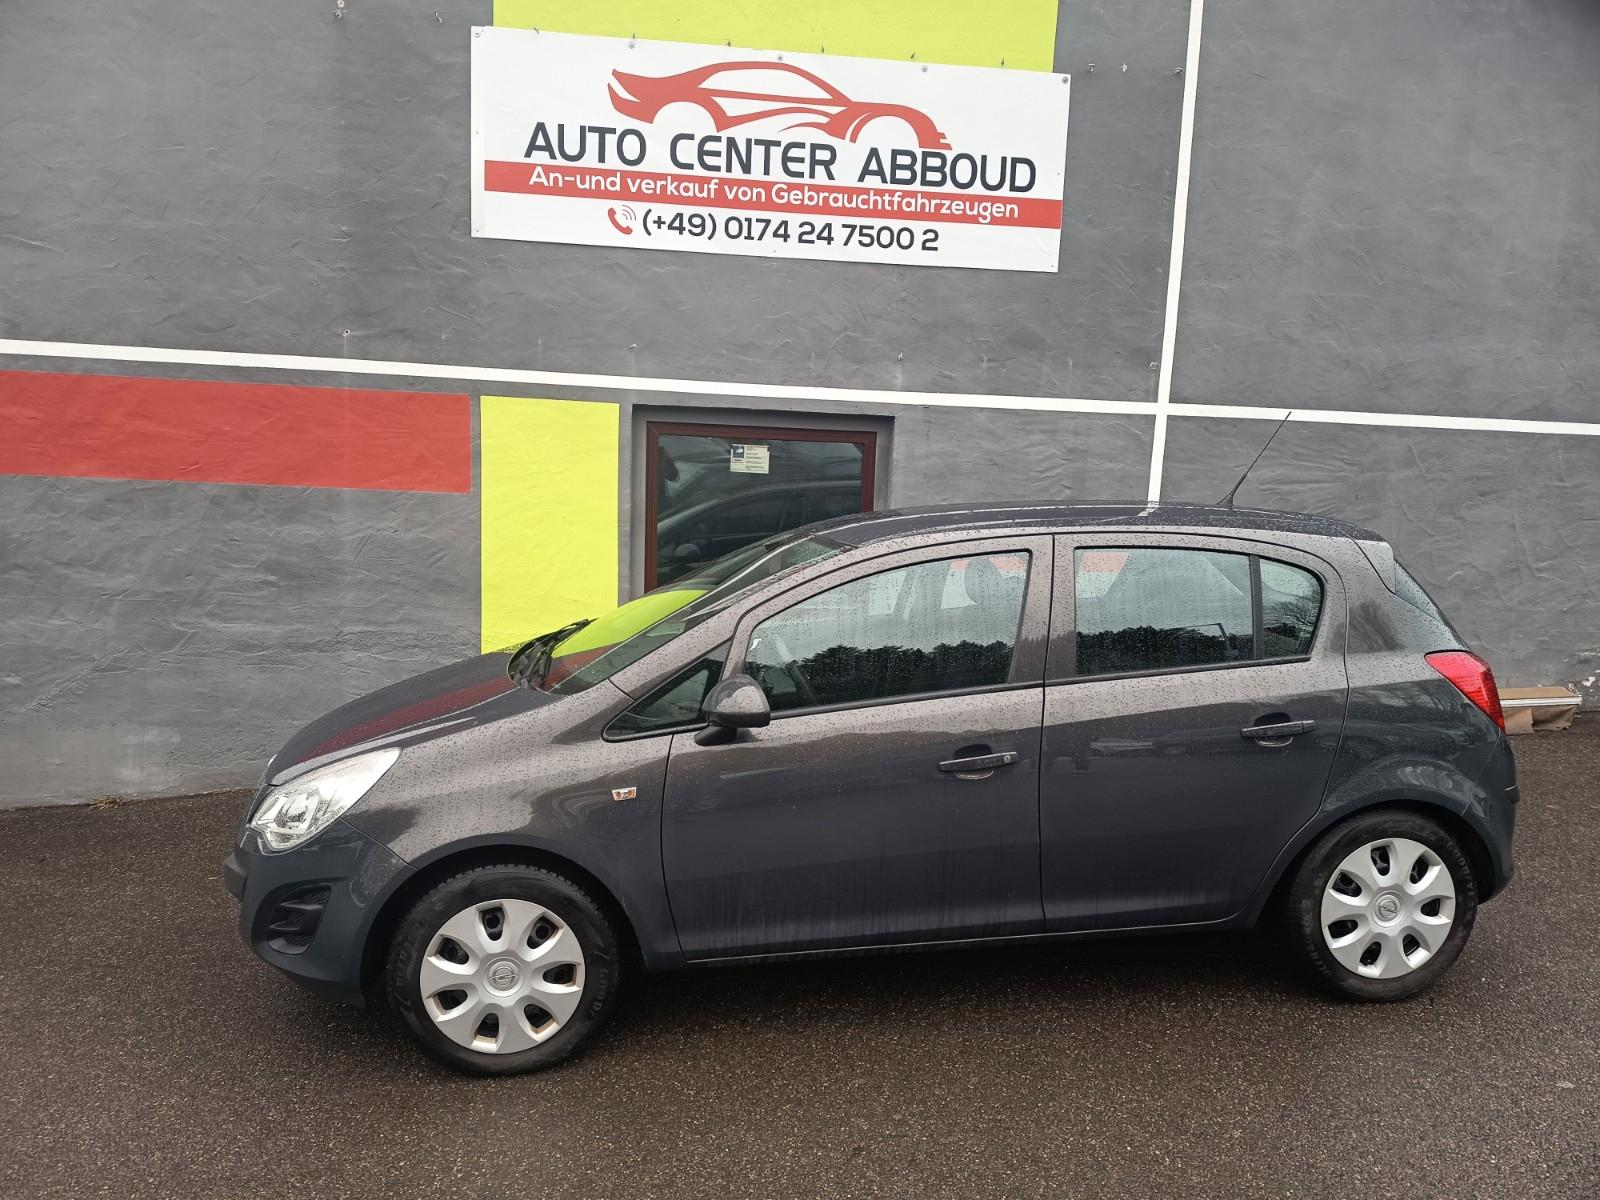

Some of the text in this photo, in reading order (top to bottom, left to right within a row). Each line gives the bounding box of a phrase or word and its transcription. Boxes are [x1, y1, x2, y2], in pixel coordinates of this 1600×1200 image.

[523, 121, 1037, 193] AUTO CENTER ABBOUD
[528, 164, 1020, 224] An-und verkauf von Gebrauchtfahrzeugen
[642, 208, 939, 252] (+49) 0174 24 7500 2
